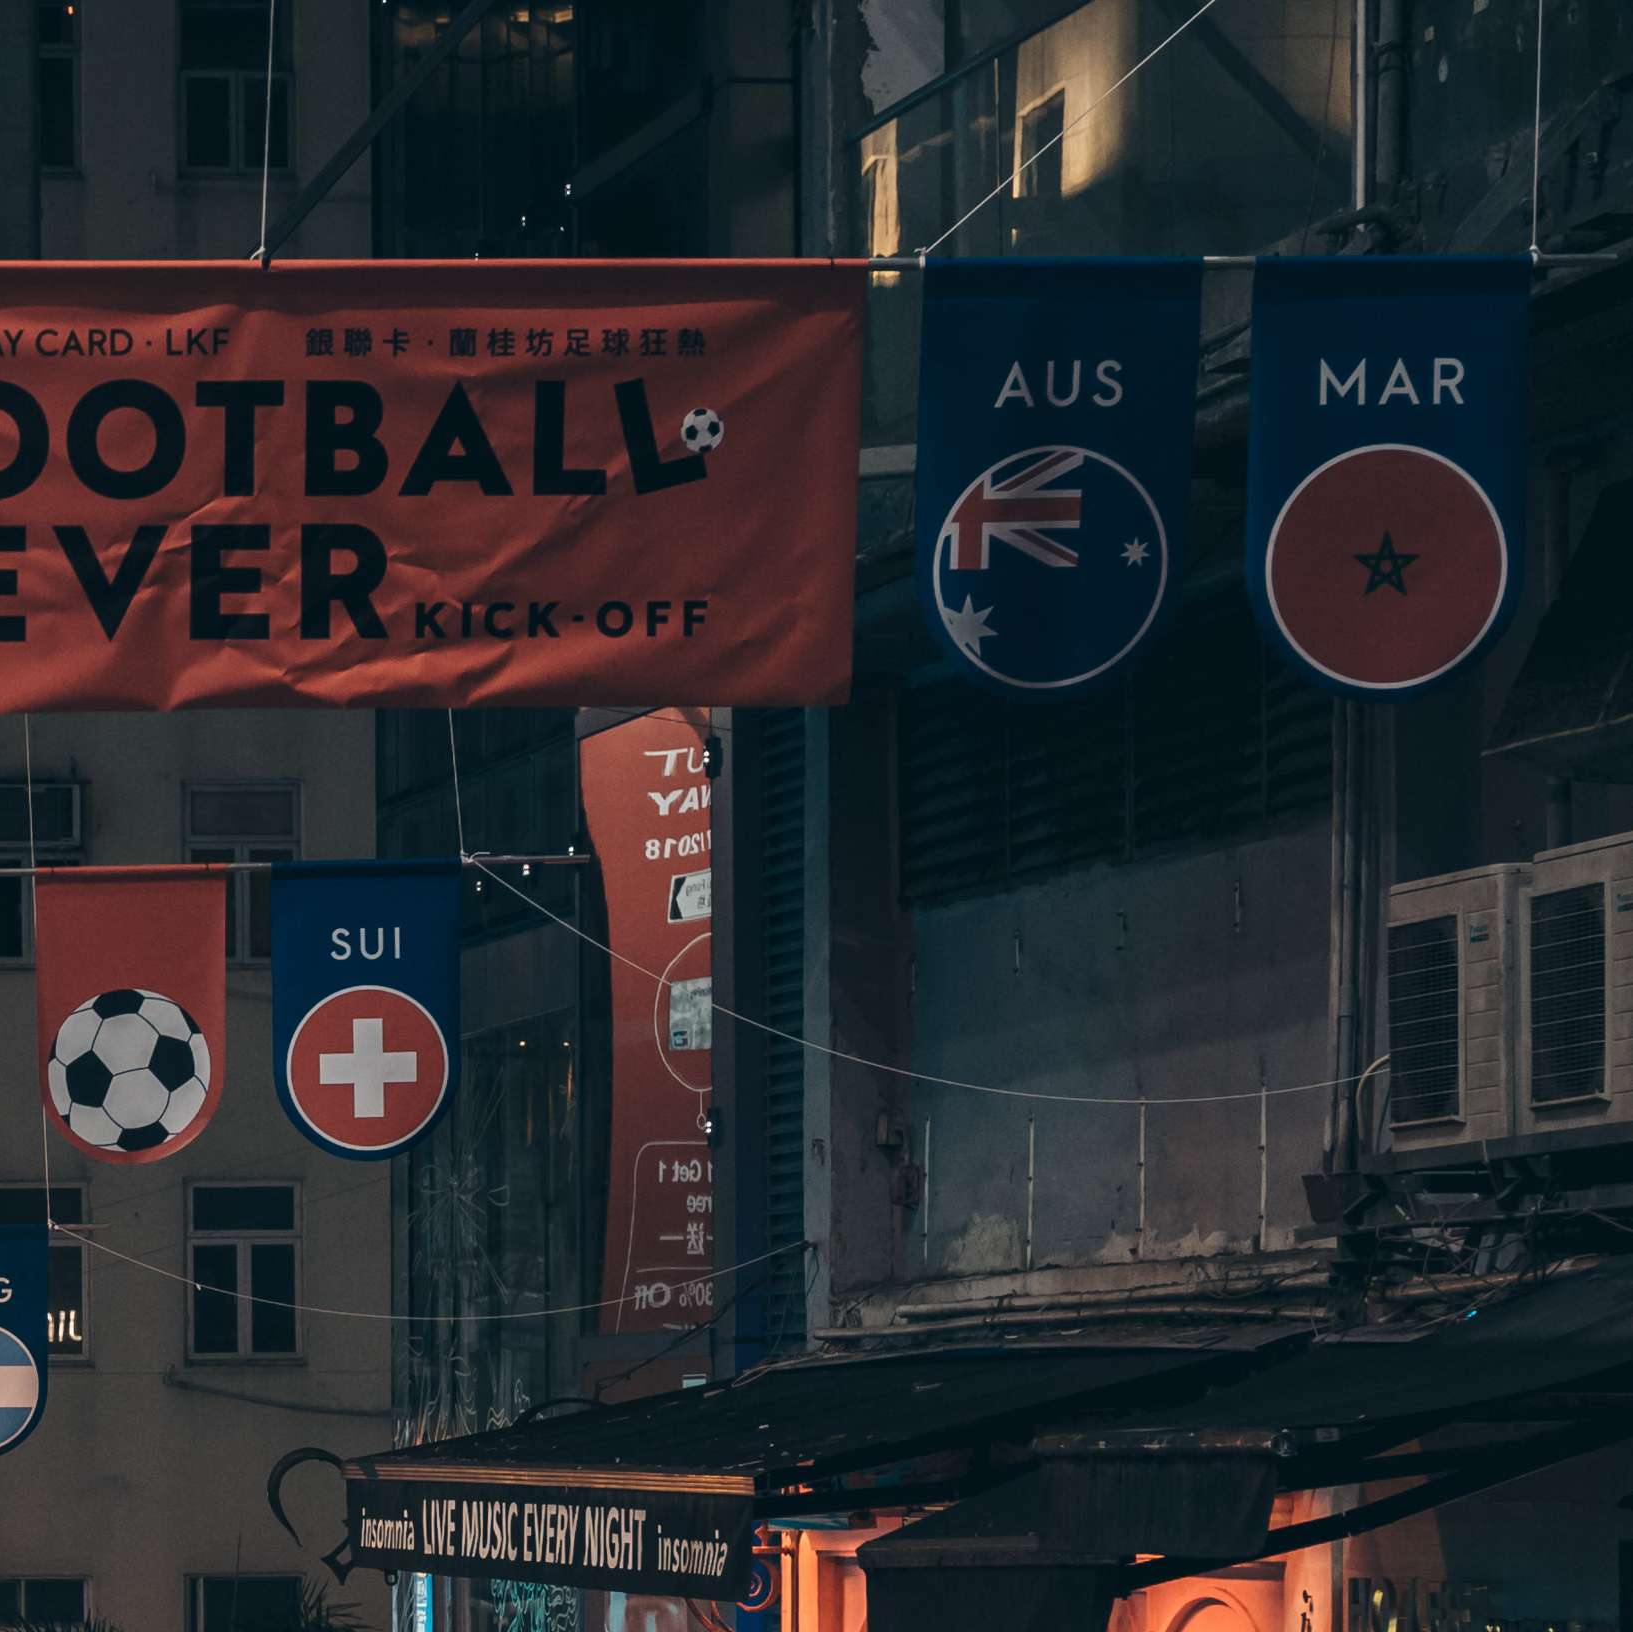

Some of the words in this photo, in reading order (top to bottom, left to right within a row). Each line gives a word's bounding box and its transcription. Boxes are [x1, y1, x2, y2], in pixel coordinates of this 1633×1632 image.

[35, 328, 133, 357] CARD
[166, 328, 230, 355] LKF
[993, 358, 1124, 408] AUS
[1318, 357, 1467, 406] MAR
[413, 601, 710, 639] KICK-OFF
[330, 927, 402, 961] SUI
[360, 1509, 415, 1551] insomnia
[422, 1499, 455, 1557] LIVE
[460, 1501, 519, 1562] MUSIC
[523, 1503, 581, 1566] EVERY
[583, 1506, 646, 1571] NIGHT
[657, 1525, 729, 1577] insomnia
